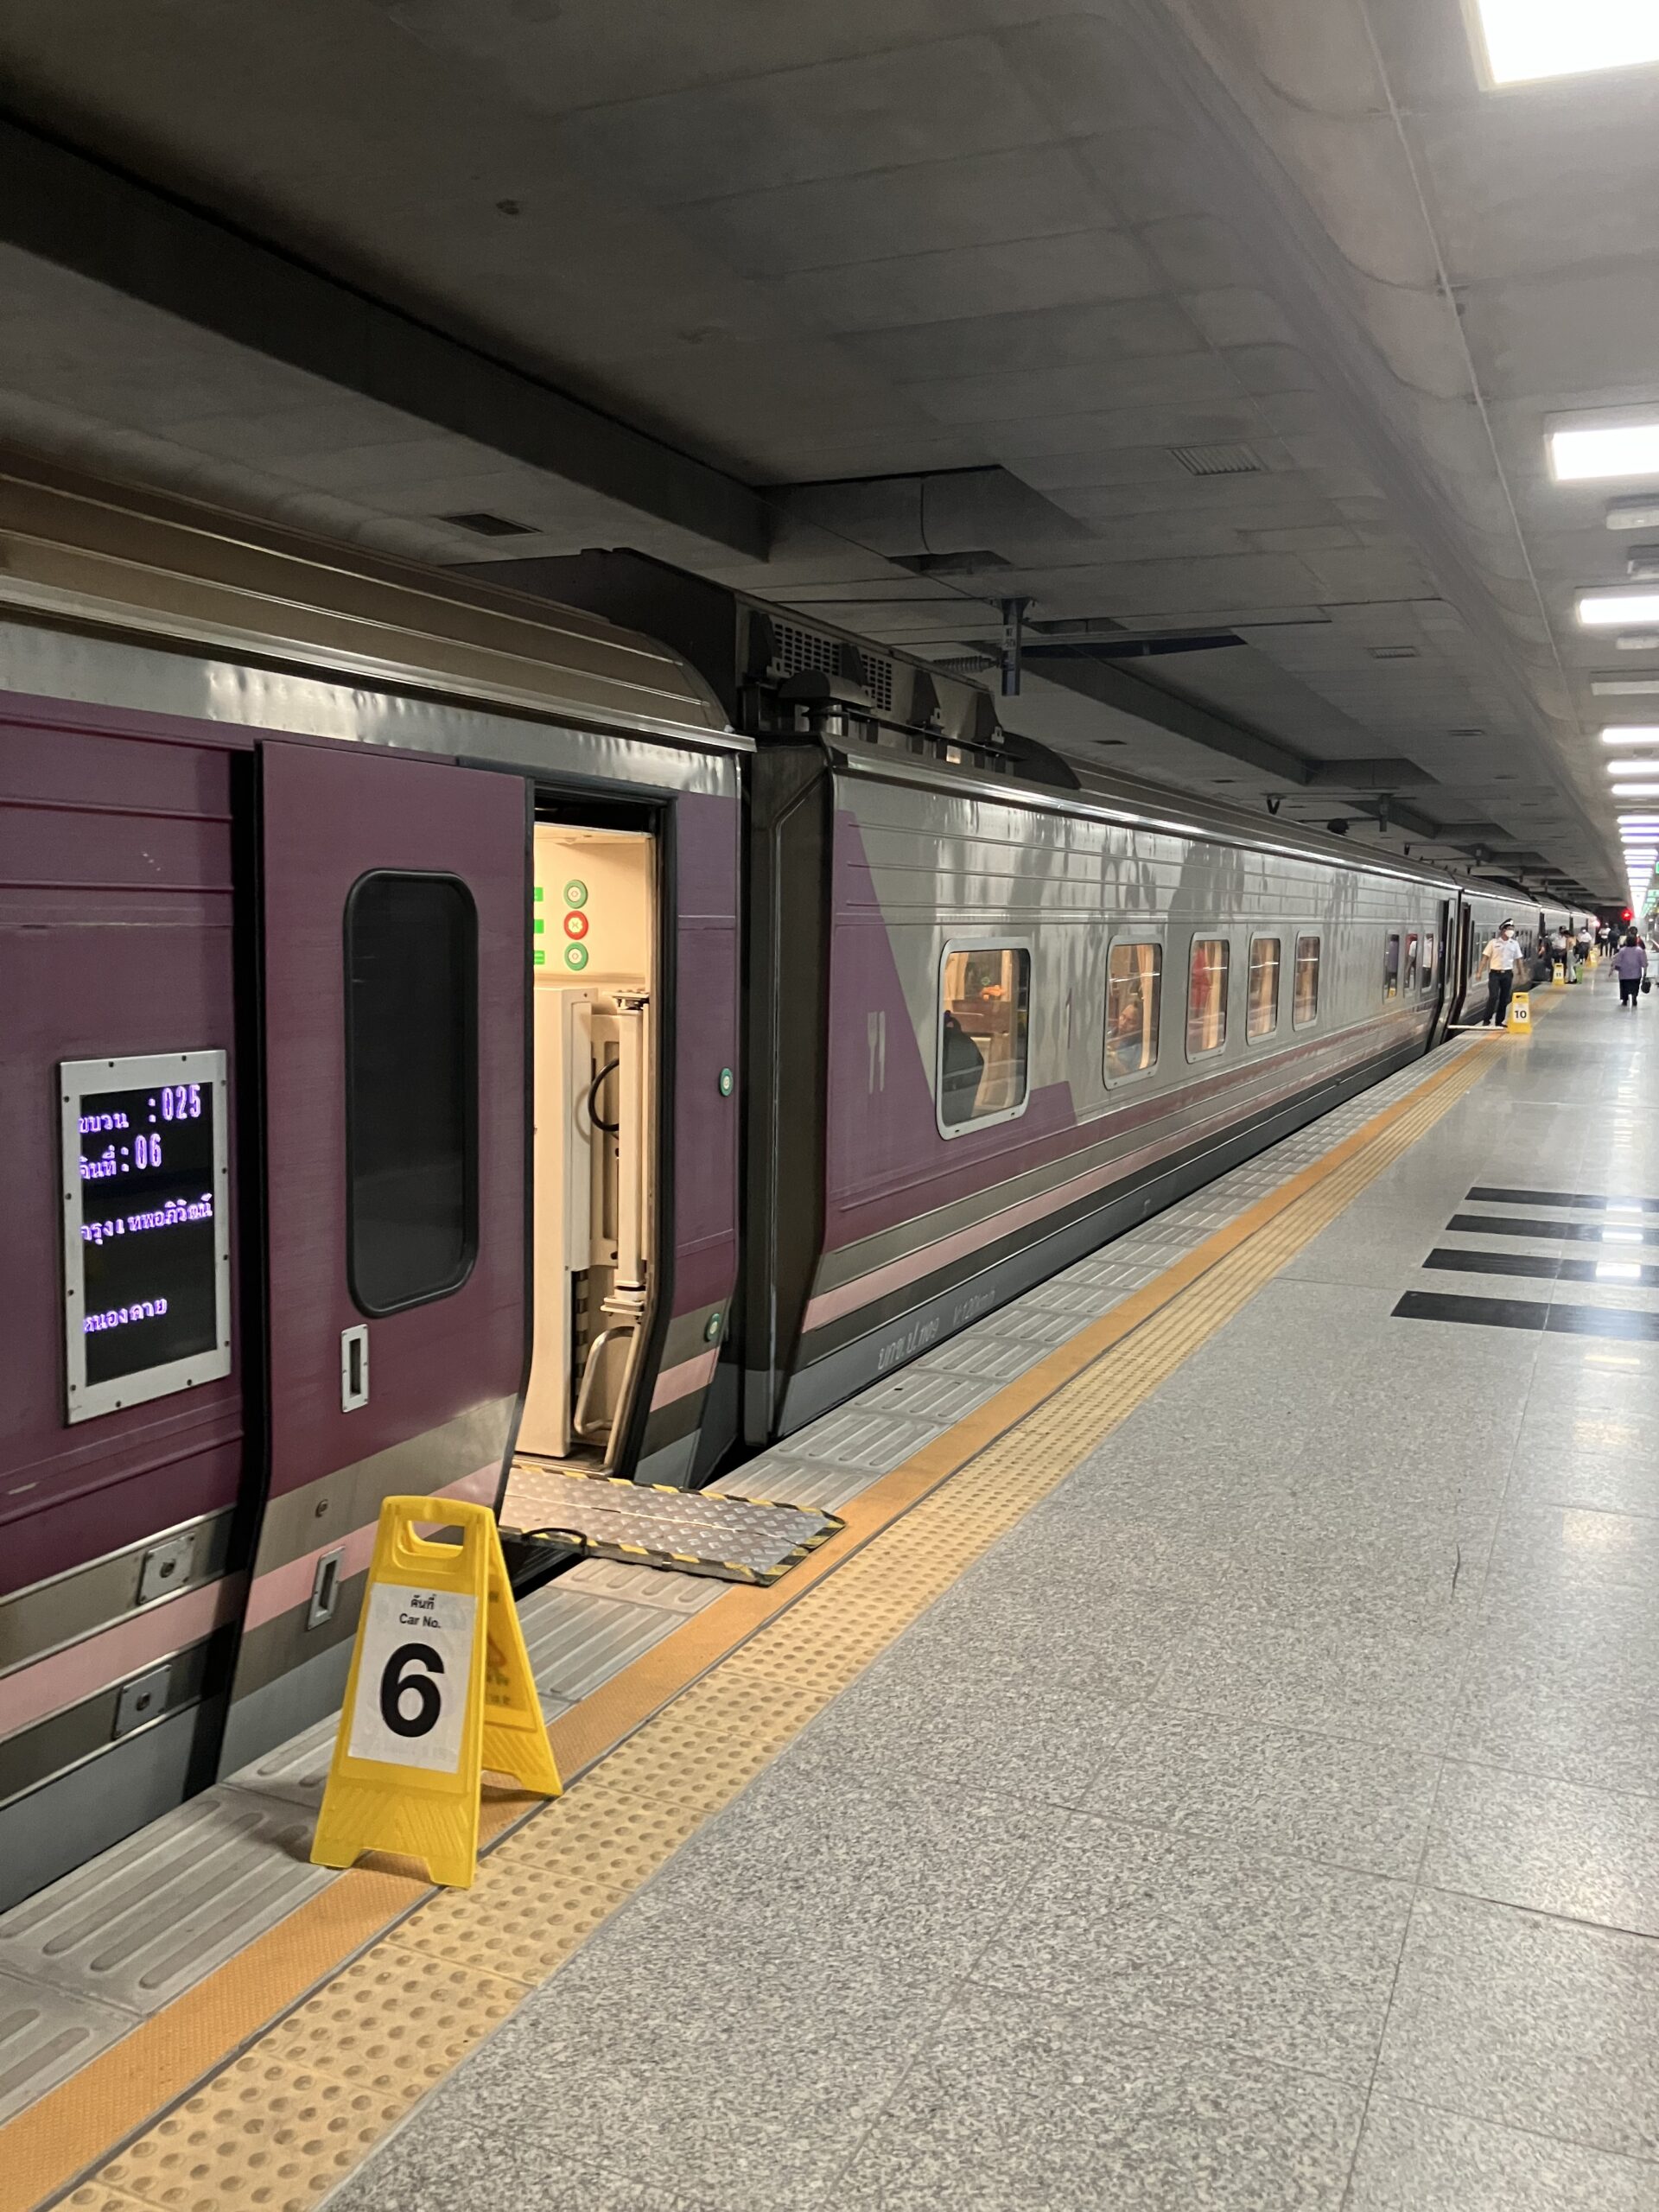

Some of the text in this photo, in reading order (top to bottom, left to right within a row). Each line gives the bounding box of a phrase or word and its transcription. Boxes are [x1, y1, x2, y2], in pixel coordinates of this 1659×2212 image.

[1514, 1010, 1527, 1019] 10
[78, 1113, 130, 1134] ขบวน
[399, 1612, 442, 1629] Car No.
[380, 1643, 445, 1738] 6
